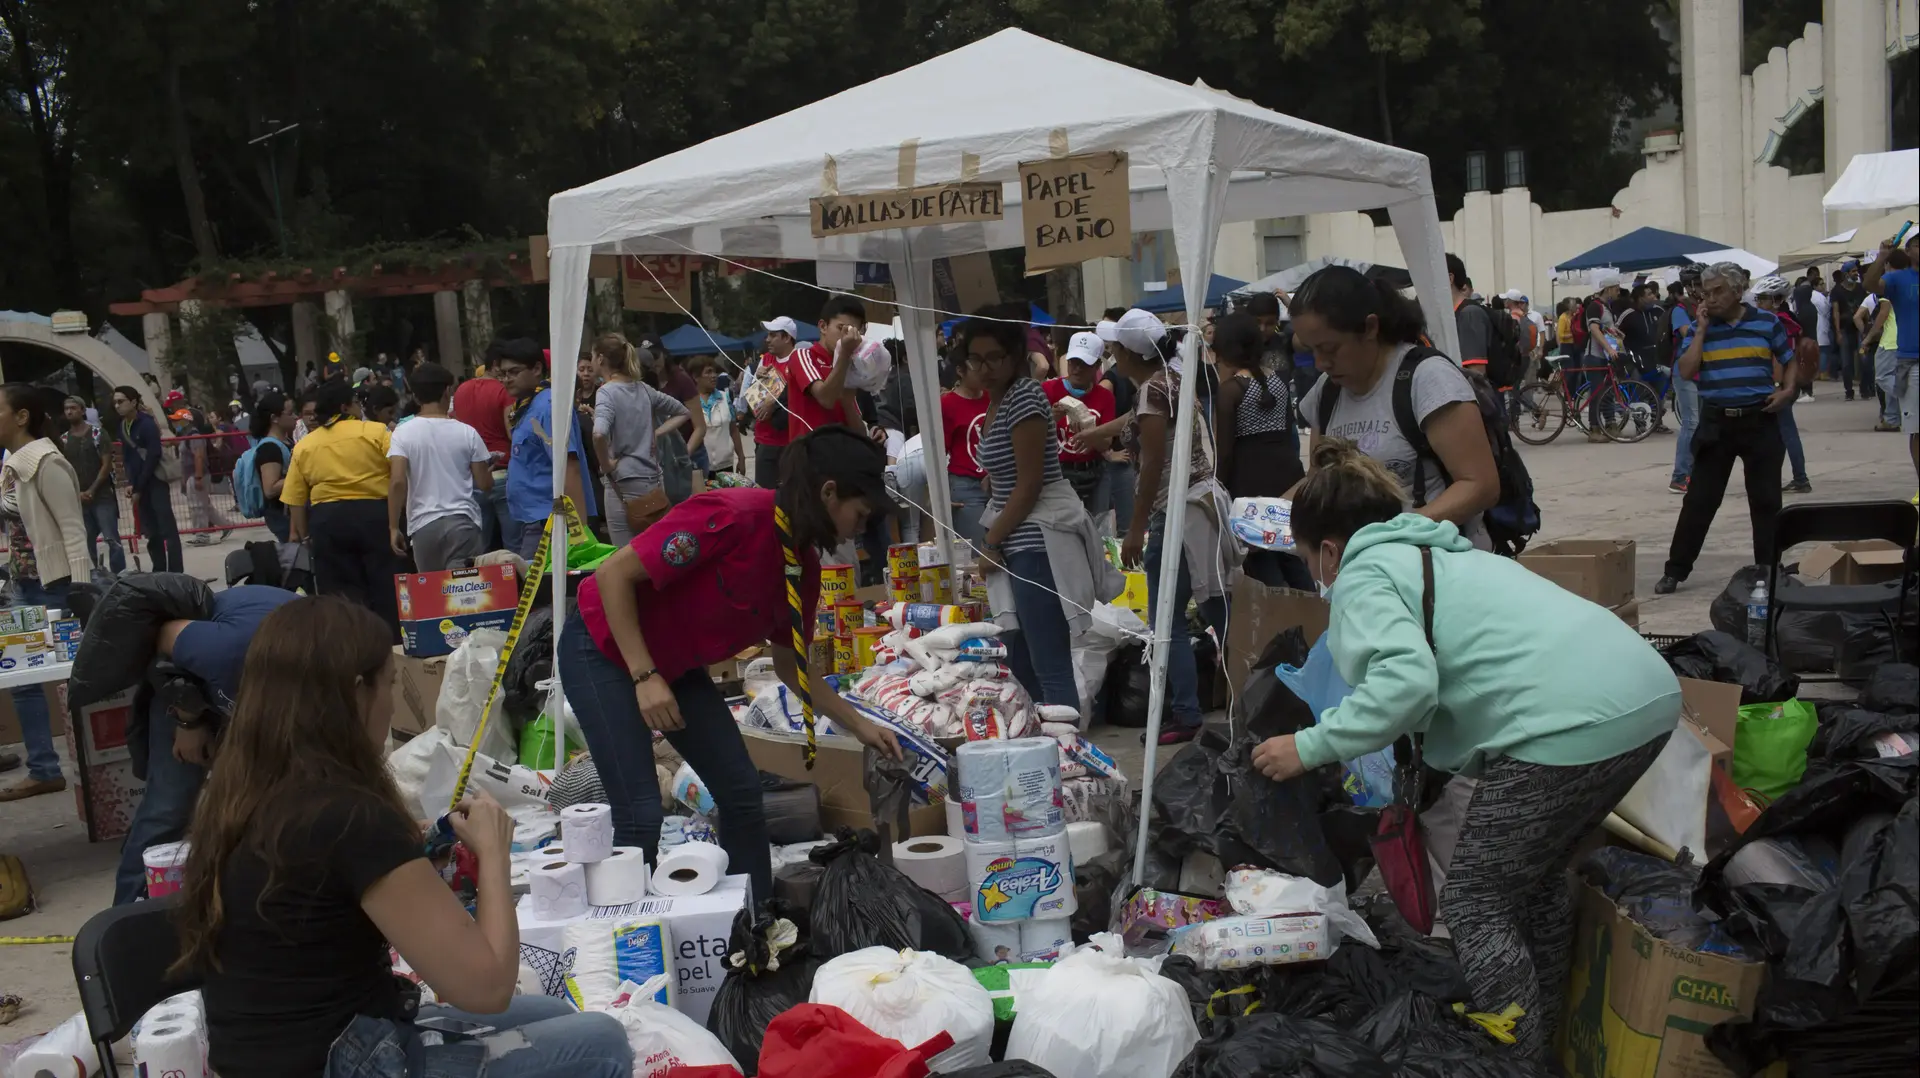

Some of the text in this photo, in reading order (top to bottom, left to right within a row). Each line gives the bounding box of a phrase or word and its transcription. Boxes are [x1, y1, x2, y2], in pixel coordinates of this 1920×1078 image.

[1026, 171, 1096, 201] PAPEL
[911, 196, 933, 220] DE
[939, 188, 1003, 217] PAPEL
[1053, 195, 1092, 220] DE
[1036, 217, 1115, 249] BAÑO
[453, 568, 478, 577] KIRKLAND
[821, 581, 847, 591] NIDO
[521, 784, 542, 798] Sal
[986, 859, 1016, 872] Jumbo
[998, 862, 1064, 896] Azálea
[674, 934, 728, 961] eta
[1661, 947, 1705, 967] FRAGIL
[677, 960, 713, 986] pel
[689, 984, 716, 995] Suave
